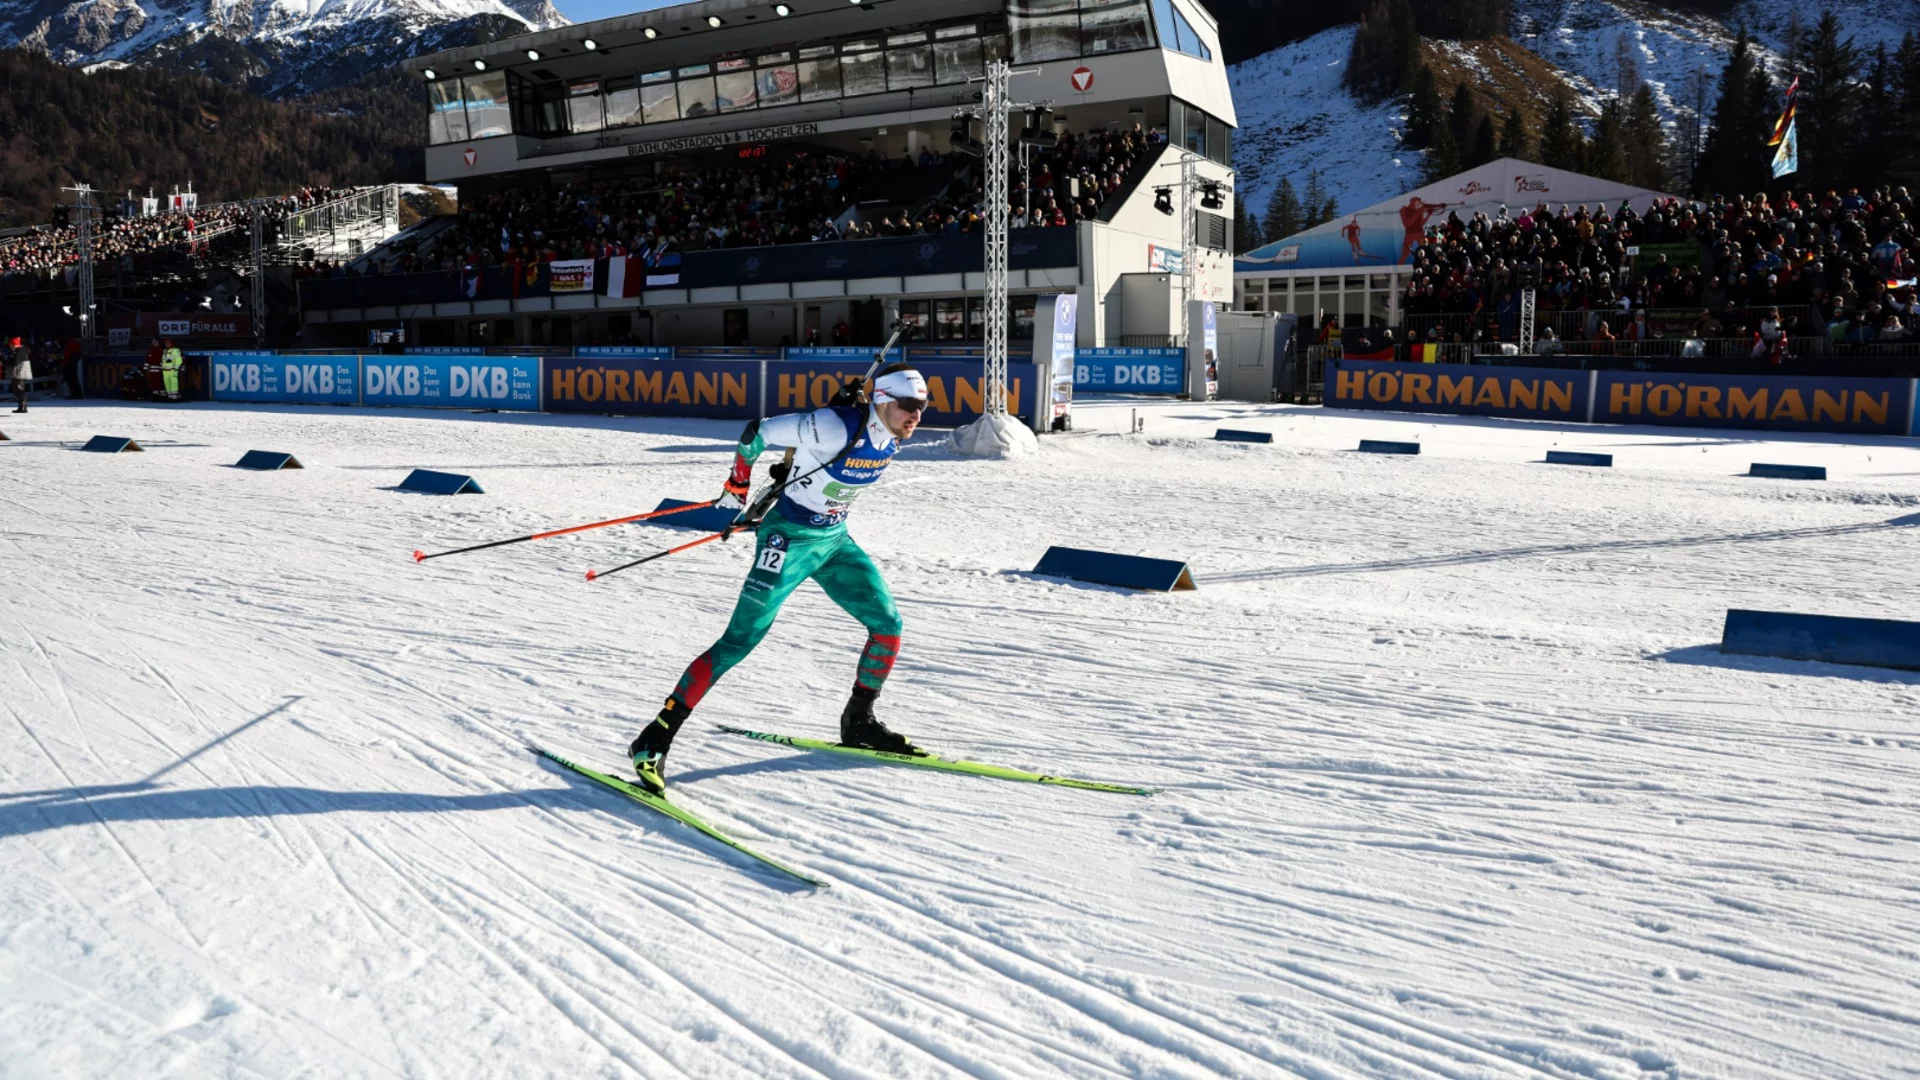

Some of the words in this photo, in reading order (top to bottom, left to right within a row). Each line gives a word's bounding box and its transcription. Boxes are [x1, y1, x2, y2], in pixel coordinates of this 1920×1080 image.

[628, 134, 722, 156] BIATHLONSTADION
[747, 123, 818, 141] HOCHFILZEN
[161, 323, 188, 333] ORF
[191, 321, 212, 333] FÜR
[213, 322, 237, 333] ALLE
[215, 364, 261, 392] DKB
[285, 364, 334, 394] DKB
[424, 365, 437, 375] Das
[513, 367, 527, 377] Das
[1114, 365, 1161, 384] DKB
[366, 365, 420, 396] DKB
[424, 376, 440, 386] kann
[450, 365, 509, 399] DKB
[513, 379, 531, 389] kann
[552, 366, 747, 407] HÖRMANN
[424, 387, 440, 397] Bank
[513, 391, 531, 400] Bank
[1335, 368, 1573, 413] HÖRMANN
[1609, 381, 1890, 425] HÖRMANN
[763, 550, 780, 569] 12
[875, 751, 913, 761] FISCHER
